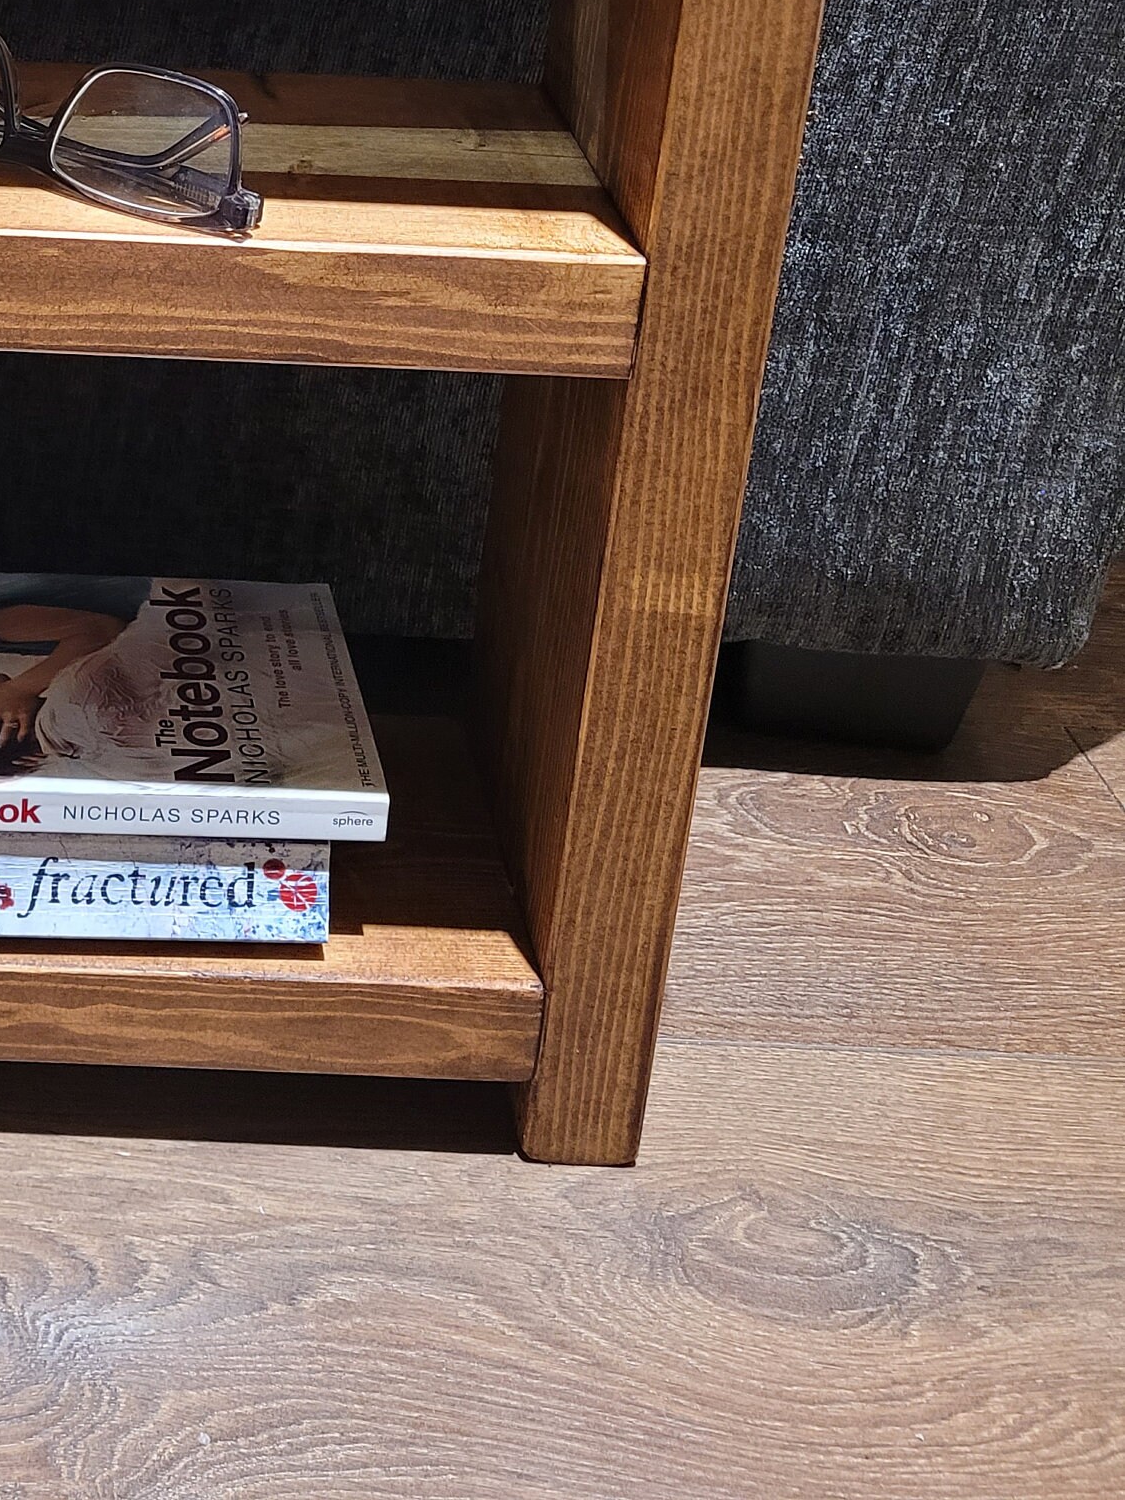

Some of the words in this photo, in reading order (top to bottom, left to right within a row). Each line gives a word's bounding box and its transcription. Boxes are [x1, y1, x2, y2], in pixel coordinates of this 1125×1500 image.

[209, 588, 245, 662] SPARKS
[260, 616, 273, 631] end
[279, 609, 293, 637] stories
[265, 633, 276, 642] to
[286, 638, 299, 657] love
[268, 645, 281, 667] story
[288, 659, 302, 671] all
[323, 633, 345, 687] INTERNATIONAL
[149, 586, 236, 783] Notebook
[274, 669, 286, 689] love
[278, 690, 291, 708] The
[155, 719, 177, 747] The
[225, 670, 270, 784] NICHOLAS
[359, 768, 377, 787] THE
[63, 805, 181, 823] NICHOLAS
[191, 809, 280, 826] SPARKS
[332, 815, 374, 827] sphere
[17, 856, 256, 919] fractured
